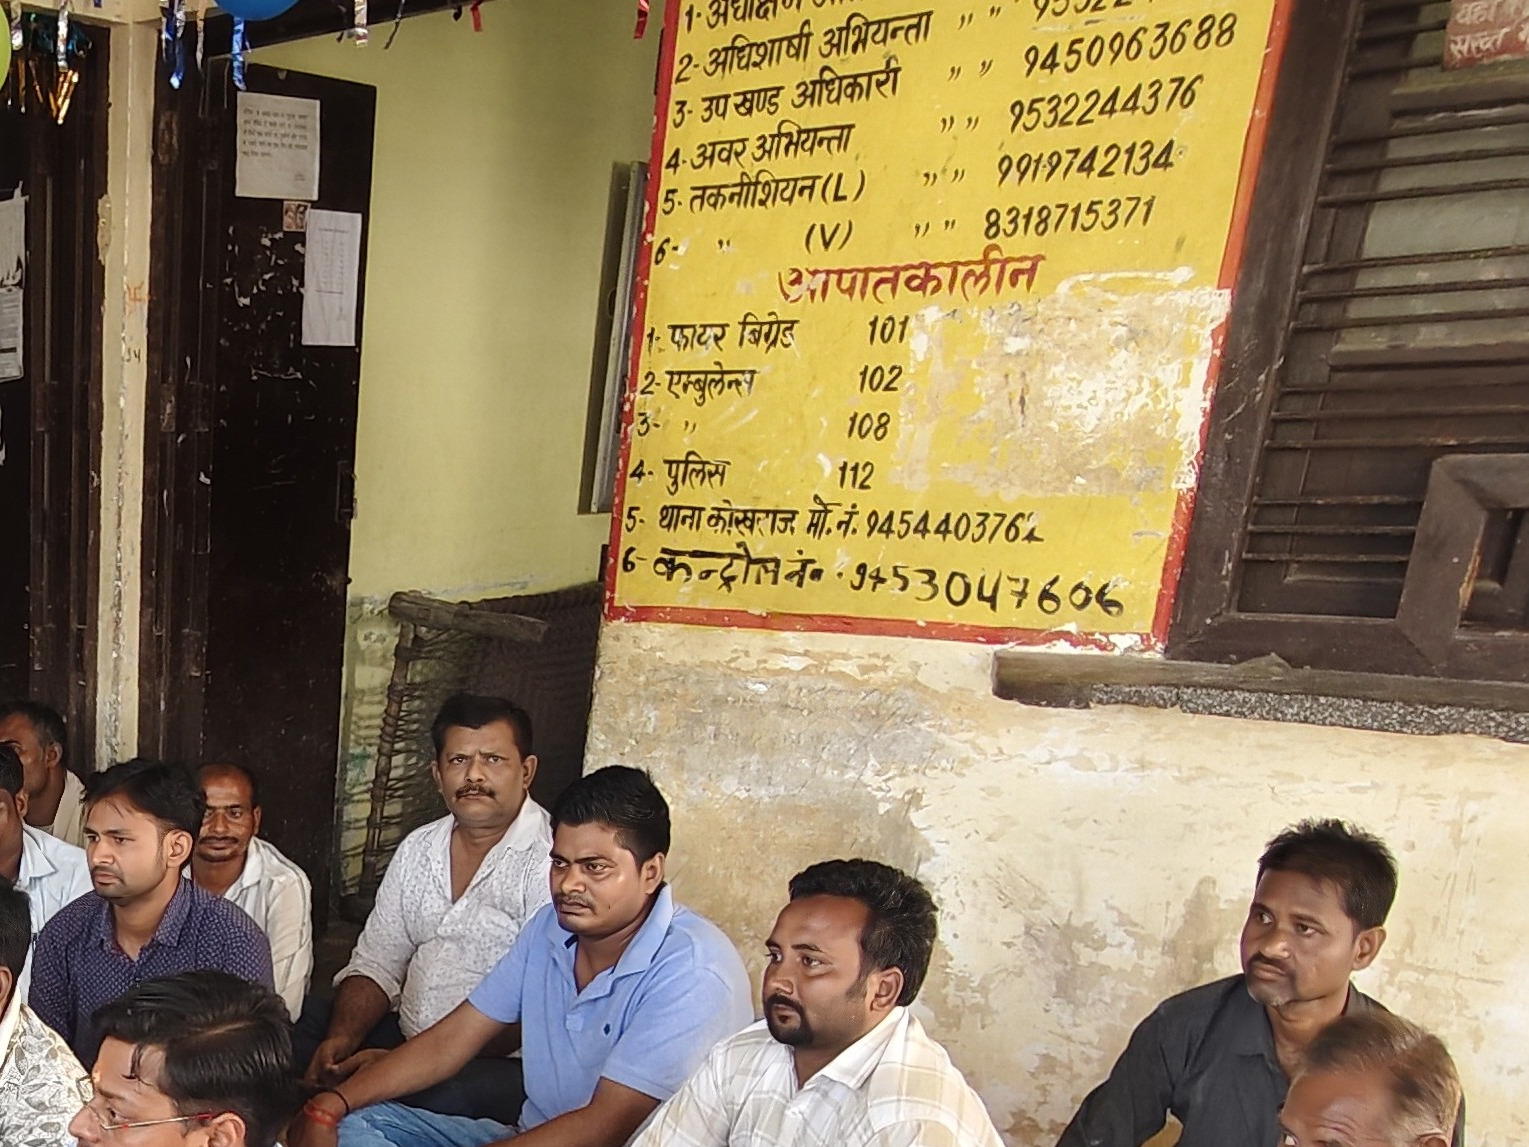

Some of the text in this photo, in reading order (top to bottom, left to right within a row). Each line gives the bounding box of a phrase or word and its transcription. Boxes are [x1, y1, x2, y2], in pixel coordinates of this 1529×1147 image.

[819, 10, 934, 60] अभियन्ता
[1024, 12, 1237, 78] 9450963688
[690, 138, 750, 170] अवर
[1009, 73, 1204, 134] 9532244376
[997, 138, 1175, 187] 9919742134
[984, 195, 1157, 240] 8318715371
[777, 243, 1046, 305] आपातकालीन
[869, 315, 910, 344] 101
[859, 365, 903, 393] 102
[847, 411, 891, 441] 108
[663, 450, 731, 496] पुलिस
[838, 460, 875, 490] 112
[659, 505, 706, 533] थाना
